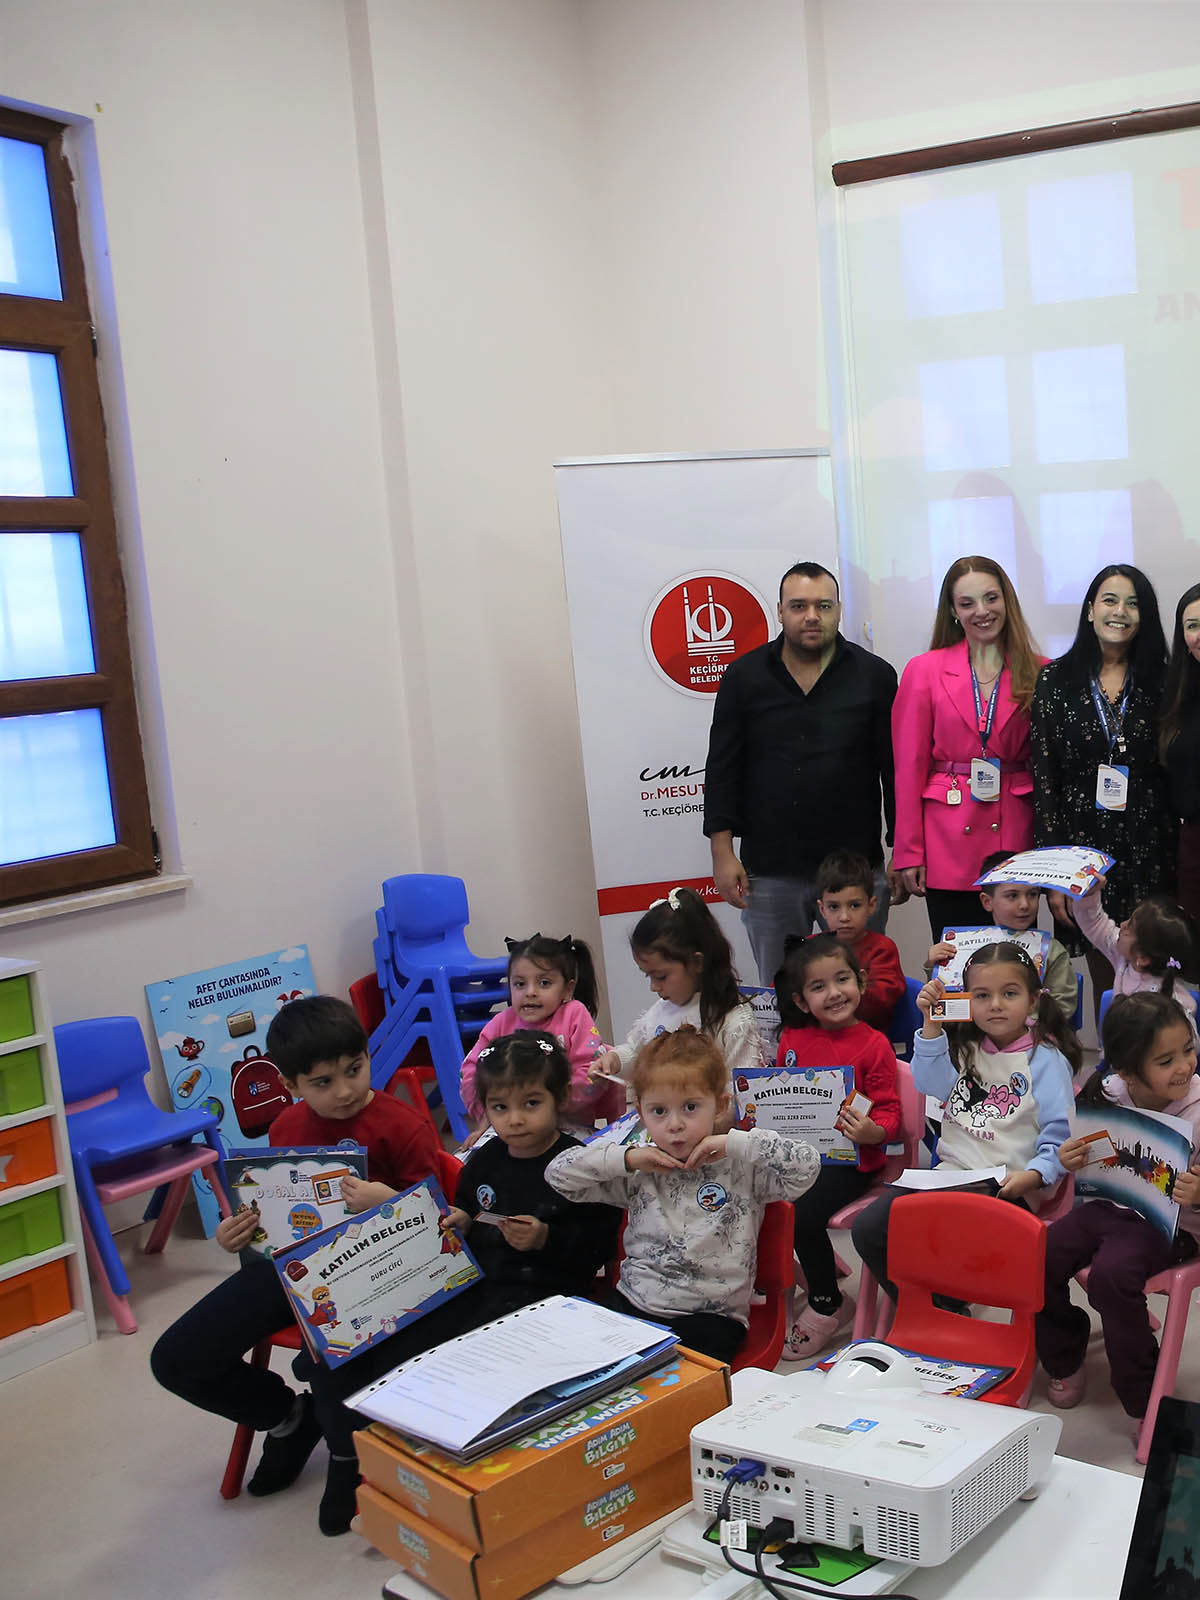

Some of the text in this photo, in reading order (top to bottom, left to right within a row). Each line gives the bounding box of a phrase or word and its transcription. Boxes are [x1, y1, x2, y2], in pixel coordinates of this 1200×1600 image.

[643, 803, 704, 818] T.C. KEÇİÖRE
[188, 976, 282, 1010] NELER BULUNMALIDIR?
[196, 967, 271, 995] AFET ÇANTASINDA
[754, 1086, 833, 1101] KATILIM BELGESİ
[319, 1238, 371, 1280] KATILIM
[371, 1212, 426, 1244] BELGESİ
[370, 1267, 388, 1282] DURU
[584, 1428, 637, 1464] BİLGİYE
[586, 1421, 631, 1451] ADIM ADIM
[583, 1490, 636, 1527] BİLGİYE
[586, 1483, 630, 1513] ADIM ADIM
